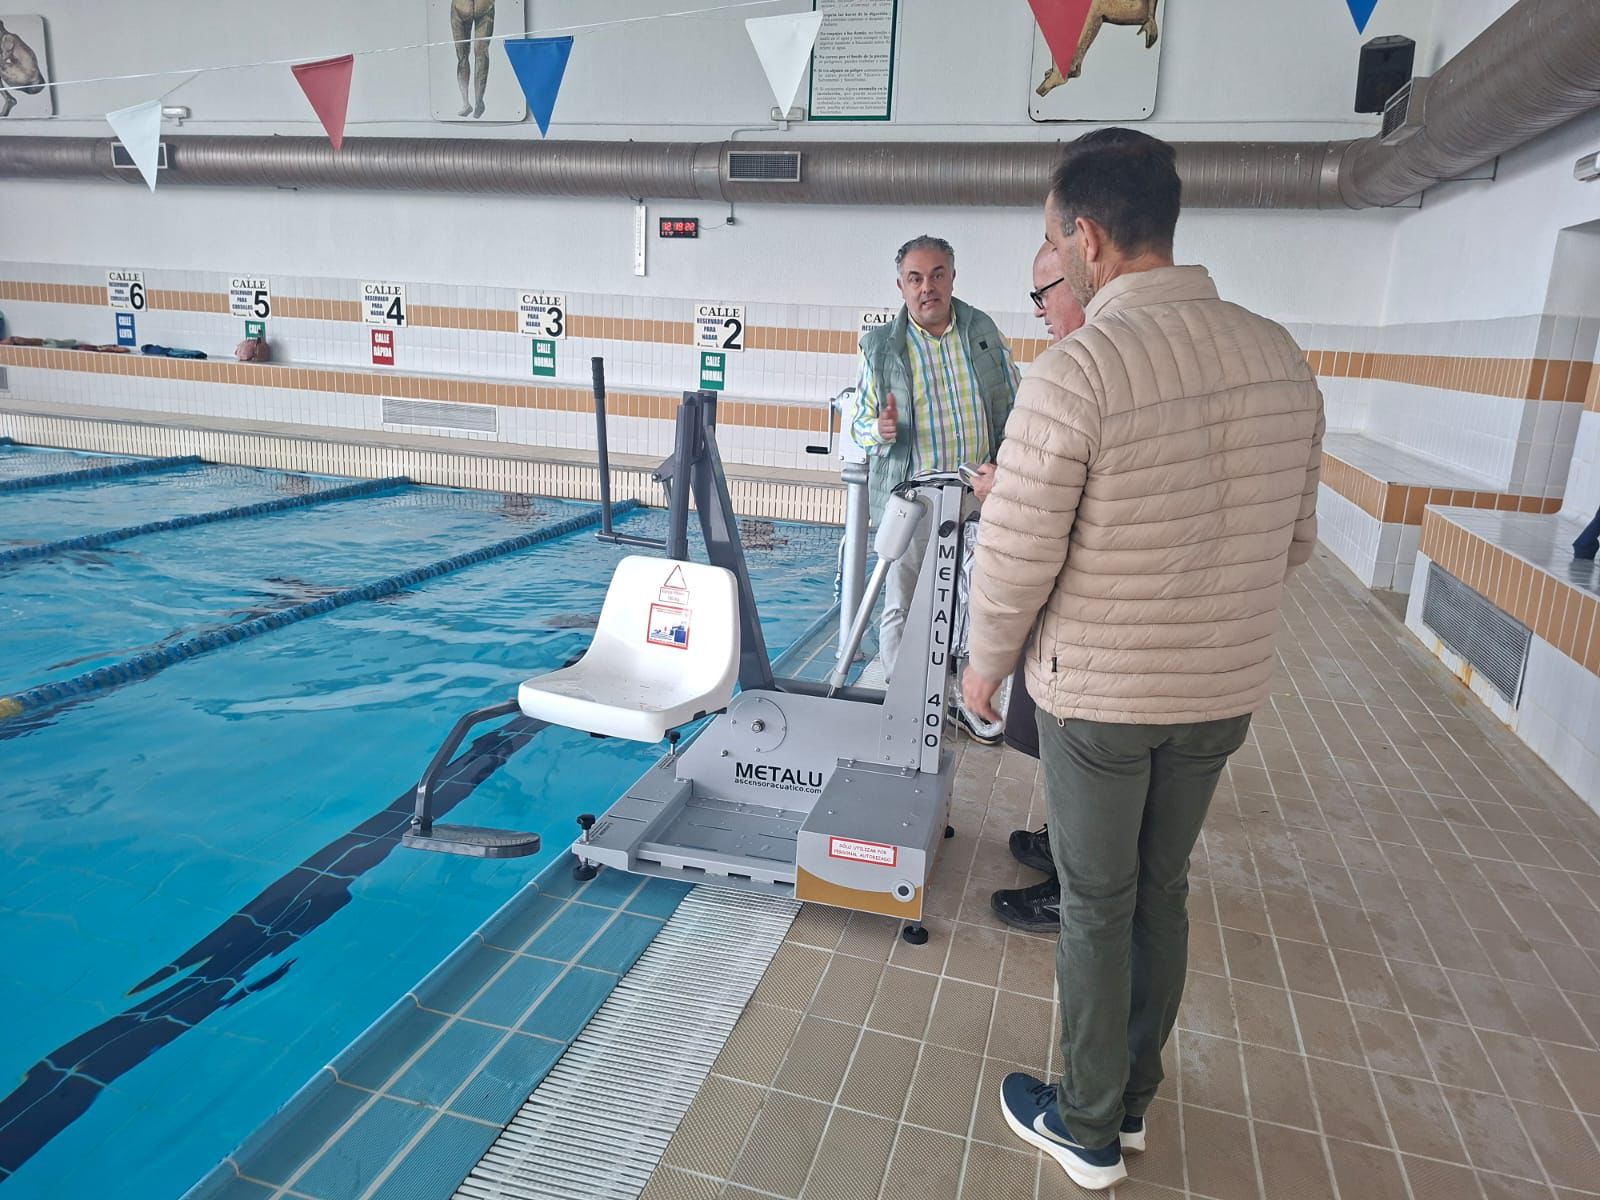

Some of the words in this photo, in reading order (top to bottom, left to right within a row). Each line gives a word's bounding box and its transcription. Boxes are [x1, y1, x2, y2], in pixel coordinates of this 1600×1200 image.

[109, 272, 140, 281] CALLE
[232, 280, 266, 289] CALLE
[365, 285, 401, 295] CALLE
[130, 283, 144, 310] 6
[522, 295, 561, 306] CALLE
[254, 290, 270, 318] 5
[386, 297, 404, 325] 4
[700, 306, 740, 317] CALLE
[546, 307, 563, 337] 3
[375, 332, 390, 344] CALLE
[723, 319, 742, 350] 2
[537, 343, 550, 354] CALLE
[705, 356, 720, 367] CALLE
[702, 370, 723, 382] NORMAL
[932, 545, 955, 665] METALU
[925, 694, 941, 747] 400
[736, 762, 822, 787] METALU
[734, 778, 822, 794] ascensoracuatico.com
